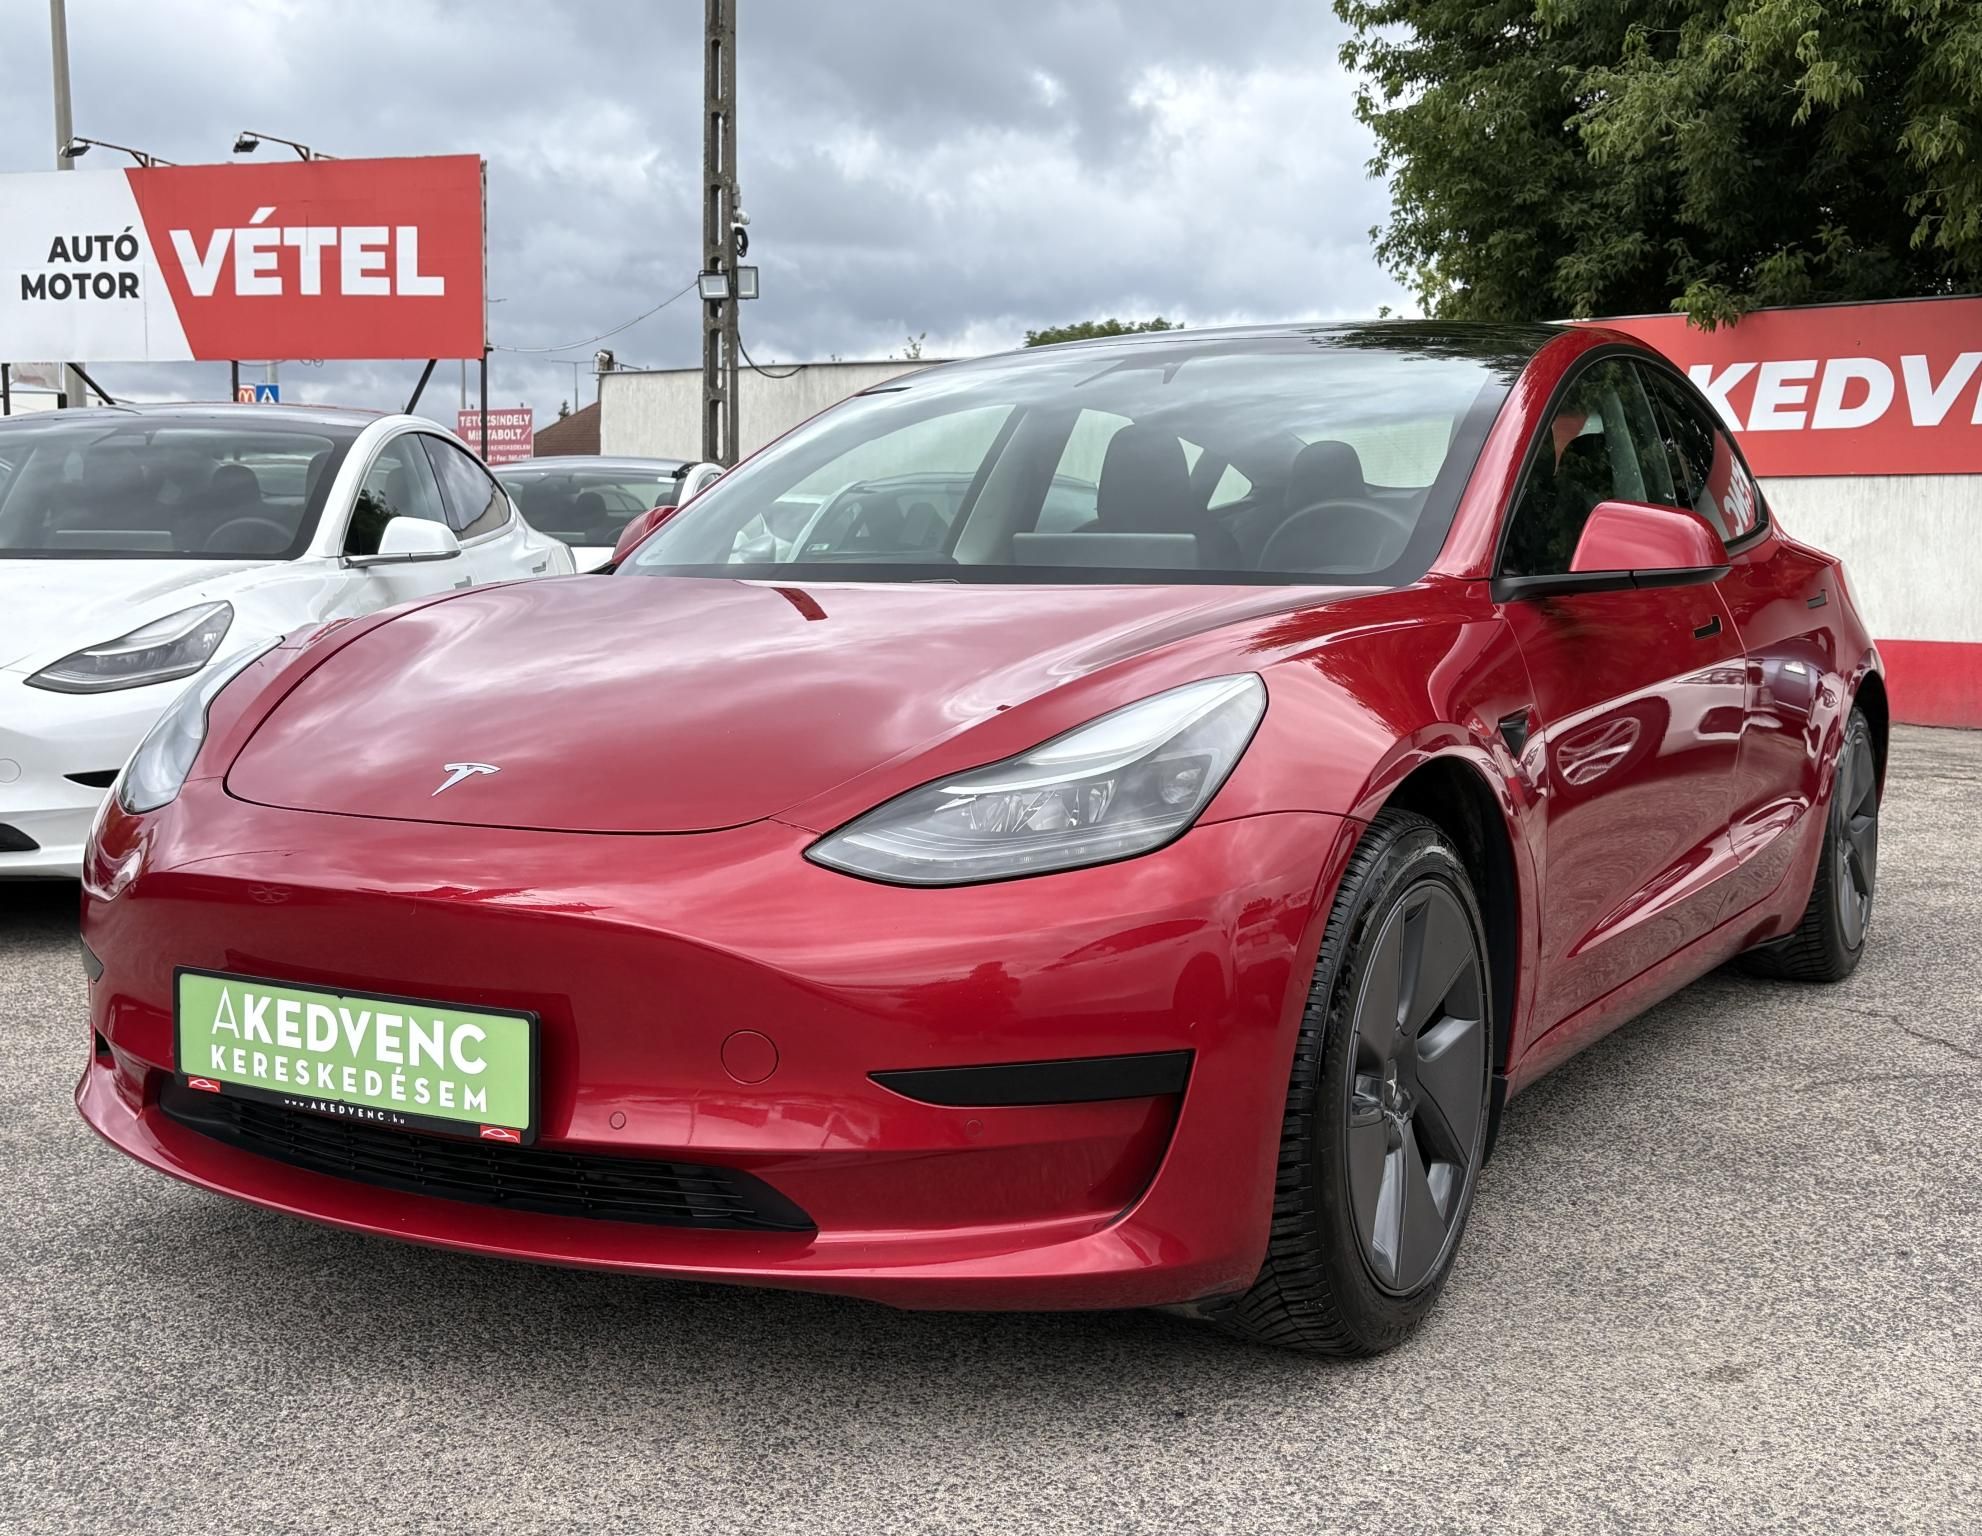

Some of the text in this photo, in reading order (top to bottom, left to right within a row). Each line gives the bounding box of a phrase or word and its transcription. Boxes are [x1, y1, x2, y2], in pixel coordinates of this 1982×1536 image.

[48, 227, 139, 262] AUTÓ
[168, 207, 444, 297] VÉTEL
[21, 273, 139, 300] MOTOR
[1688, 352, 1982, 432] KEDV
[211, 986, 488, 1075] AKEDVENC
[211, 1044, 488, 1113] KERESKEDÉSEM
